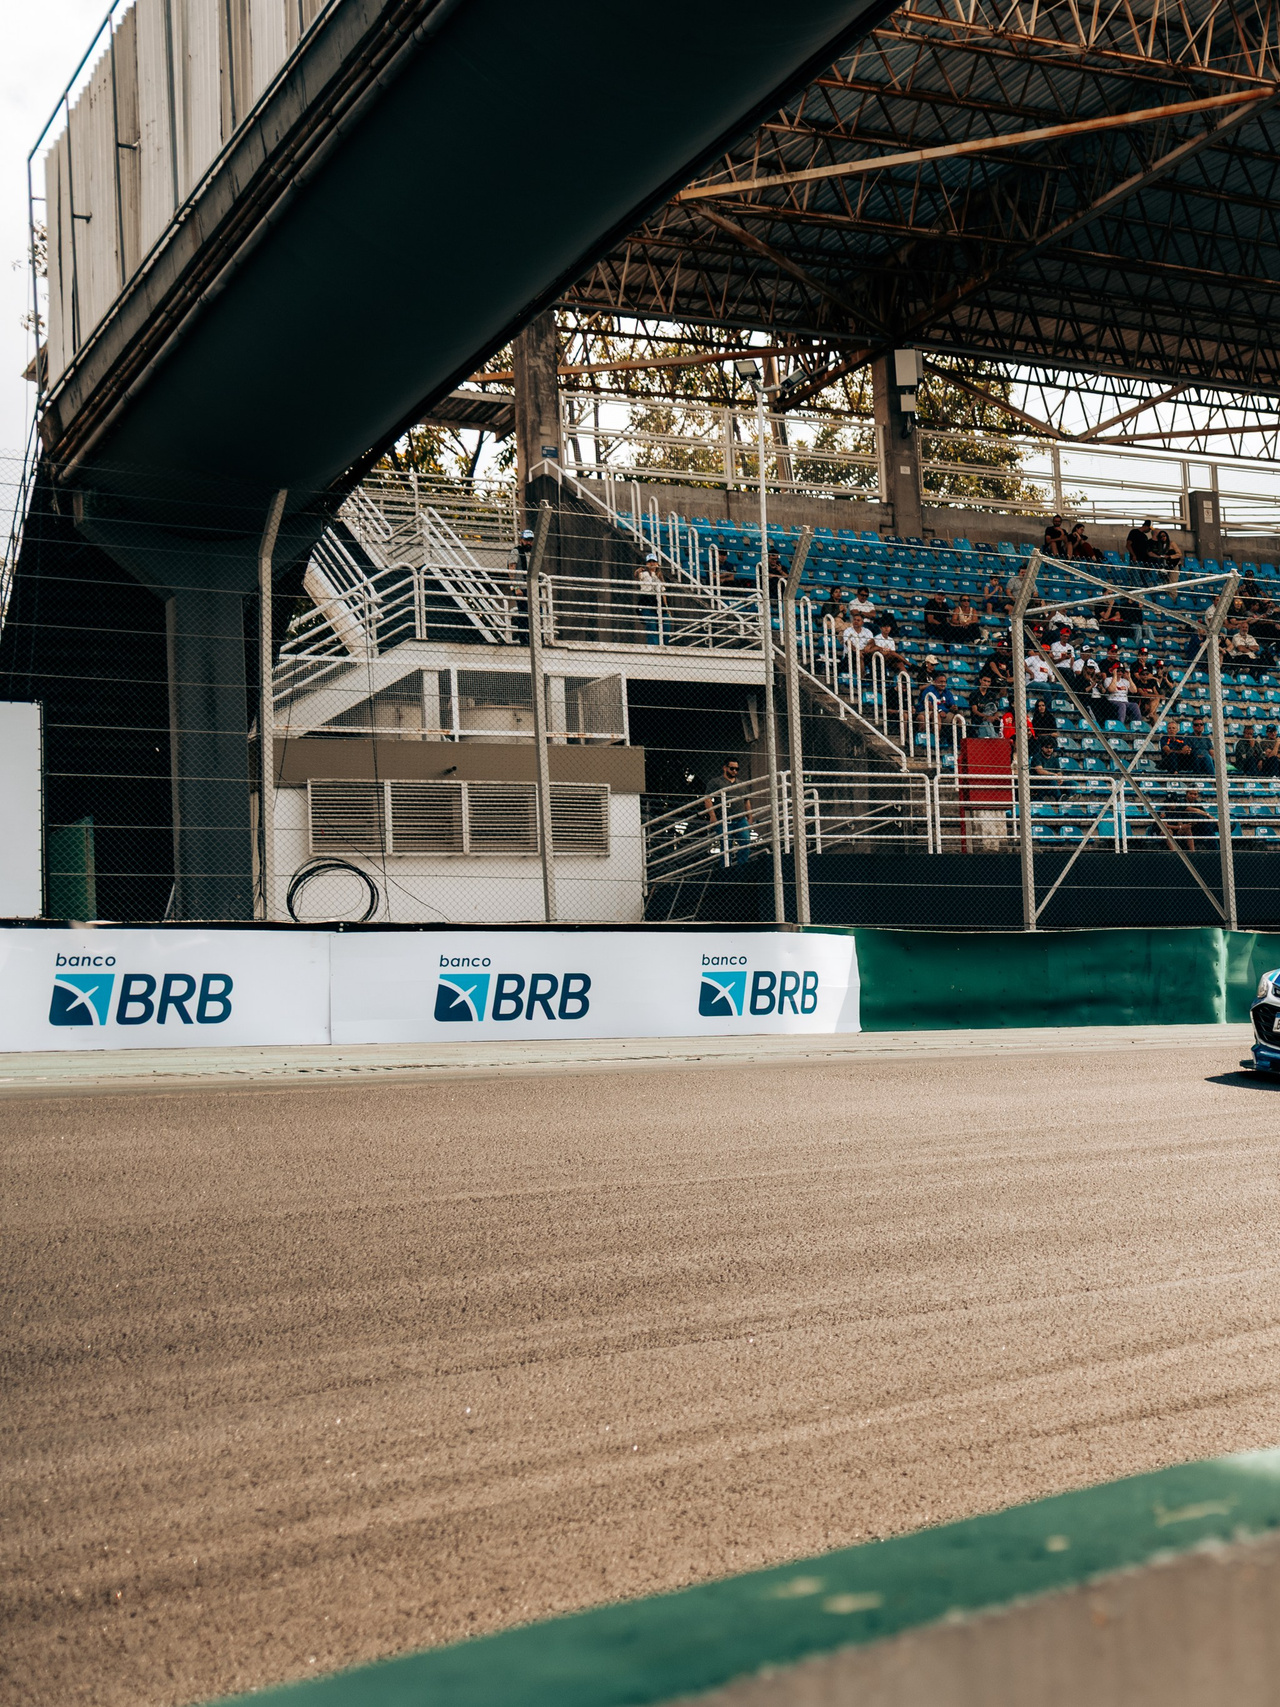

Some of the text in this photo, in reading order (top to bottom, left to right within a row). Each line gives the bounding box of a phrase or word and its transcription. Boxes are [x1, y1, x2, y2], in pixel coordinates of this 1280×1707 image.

[55, 953, 116, 967] banco
[439, 954, 491, 967] banco
[701, 954, 748, 966] banco
[115, 973, 234, 1026] BRB
[491, 972, 592, 1022] BRB
[749, 970, 819, 1016] BRB
